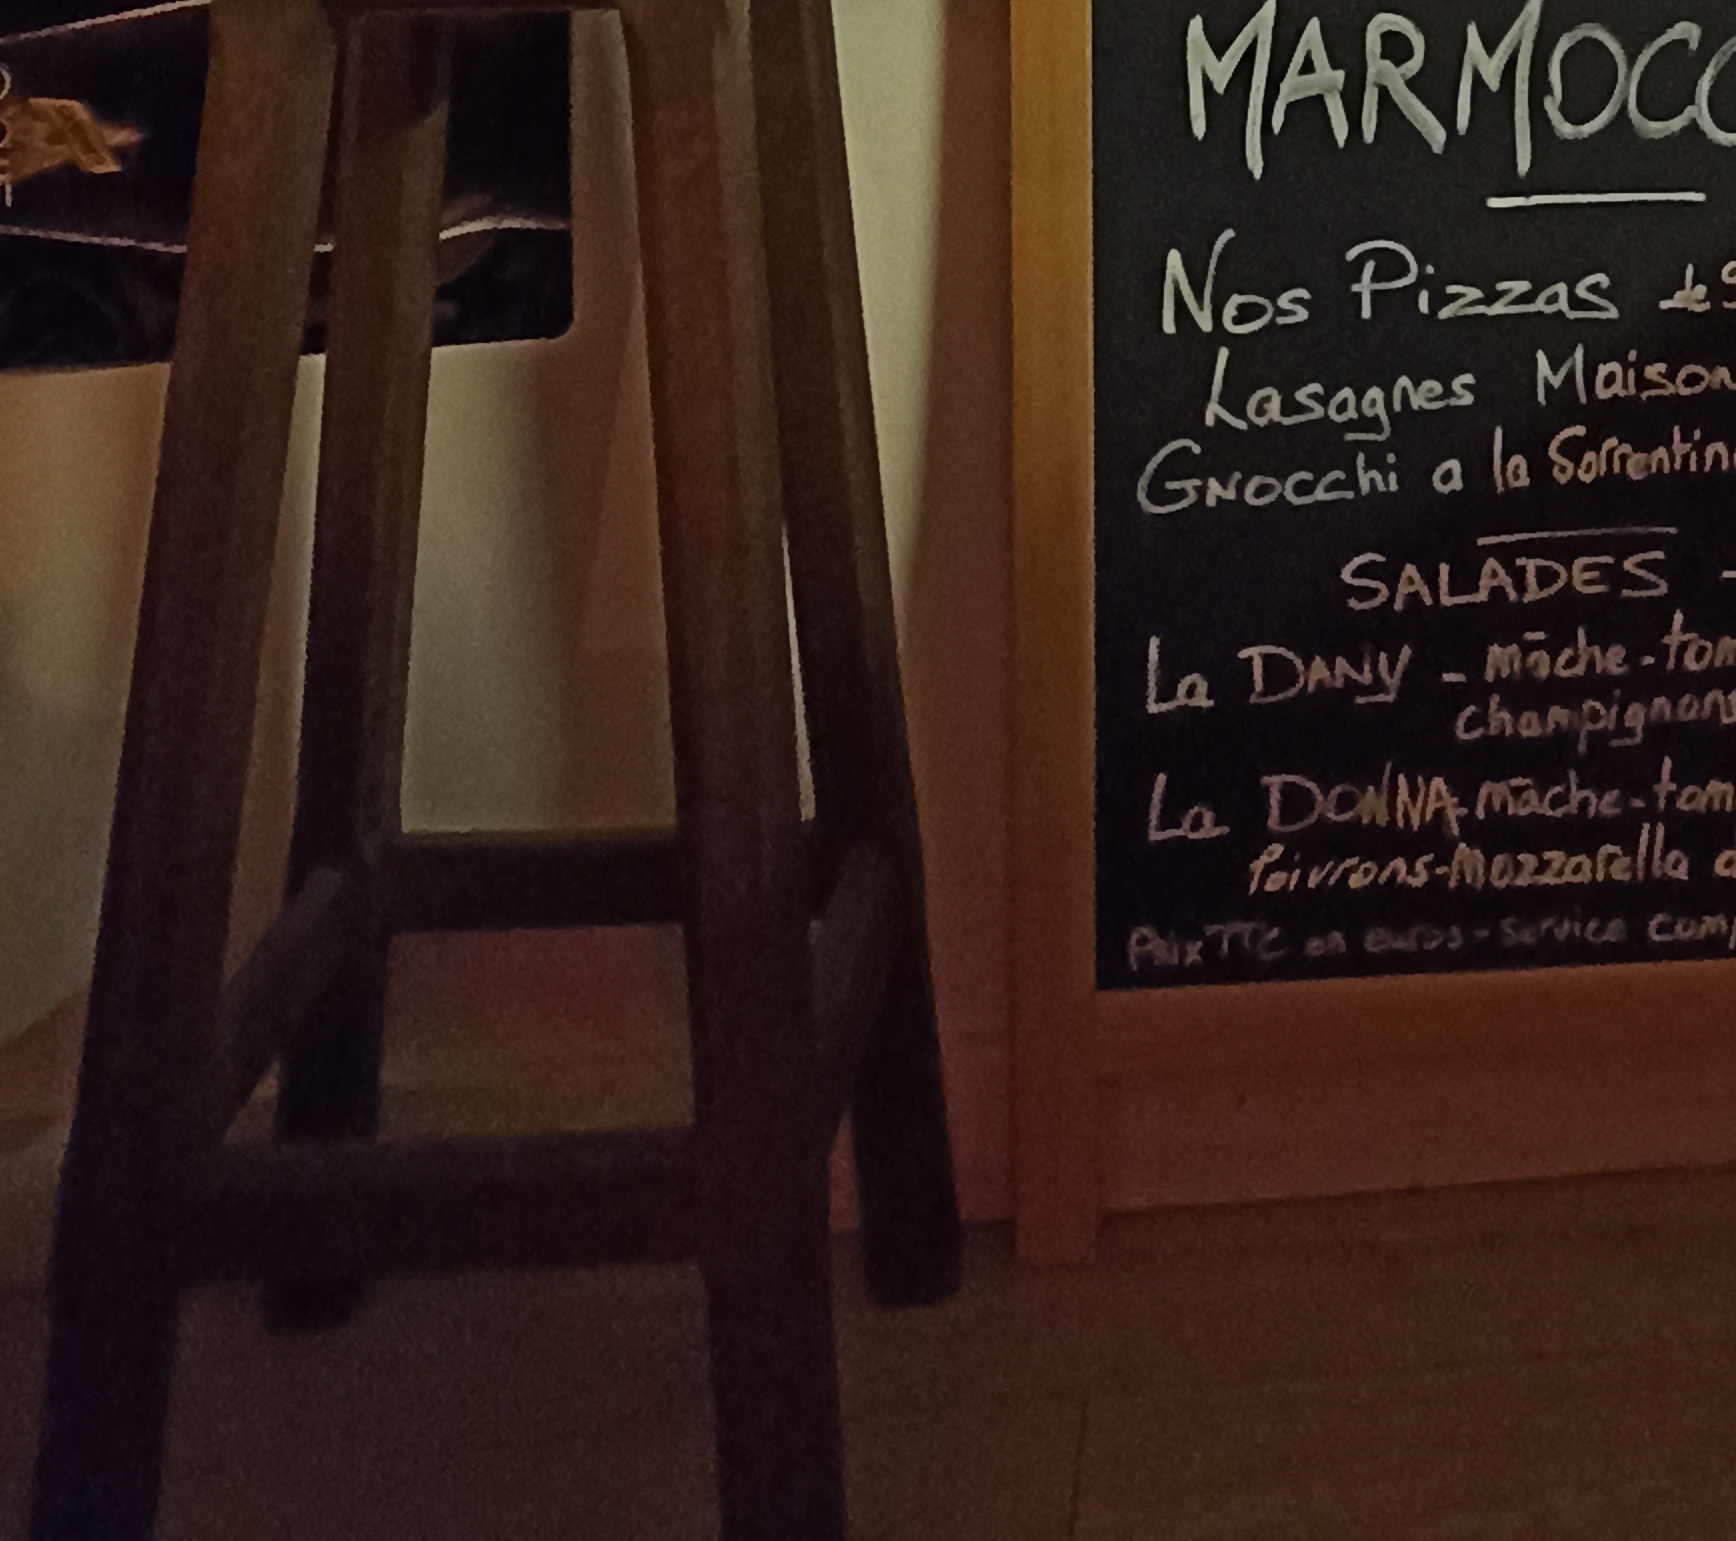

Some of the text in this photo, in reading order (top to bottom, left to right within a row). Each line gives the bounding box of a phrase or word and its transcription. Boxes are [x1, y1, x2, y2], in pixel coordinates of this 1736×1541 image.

[1162, 228, 1312, 335] Nos
[1345, 239, 1620, 320] Pizzas
[1204, 346, 1477, 441] Lasagnes
[1431, 457, 1465, 495] a
[1492, 424, 1531, 495] la
[1339, 550, 1669, 612] SALADES
[1146, 634, 1215, 715] La
[1237, 643, 1413, 706] DANY
[1147, 770, 1231, 842] La
